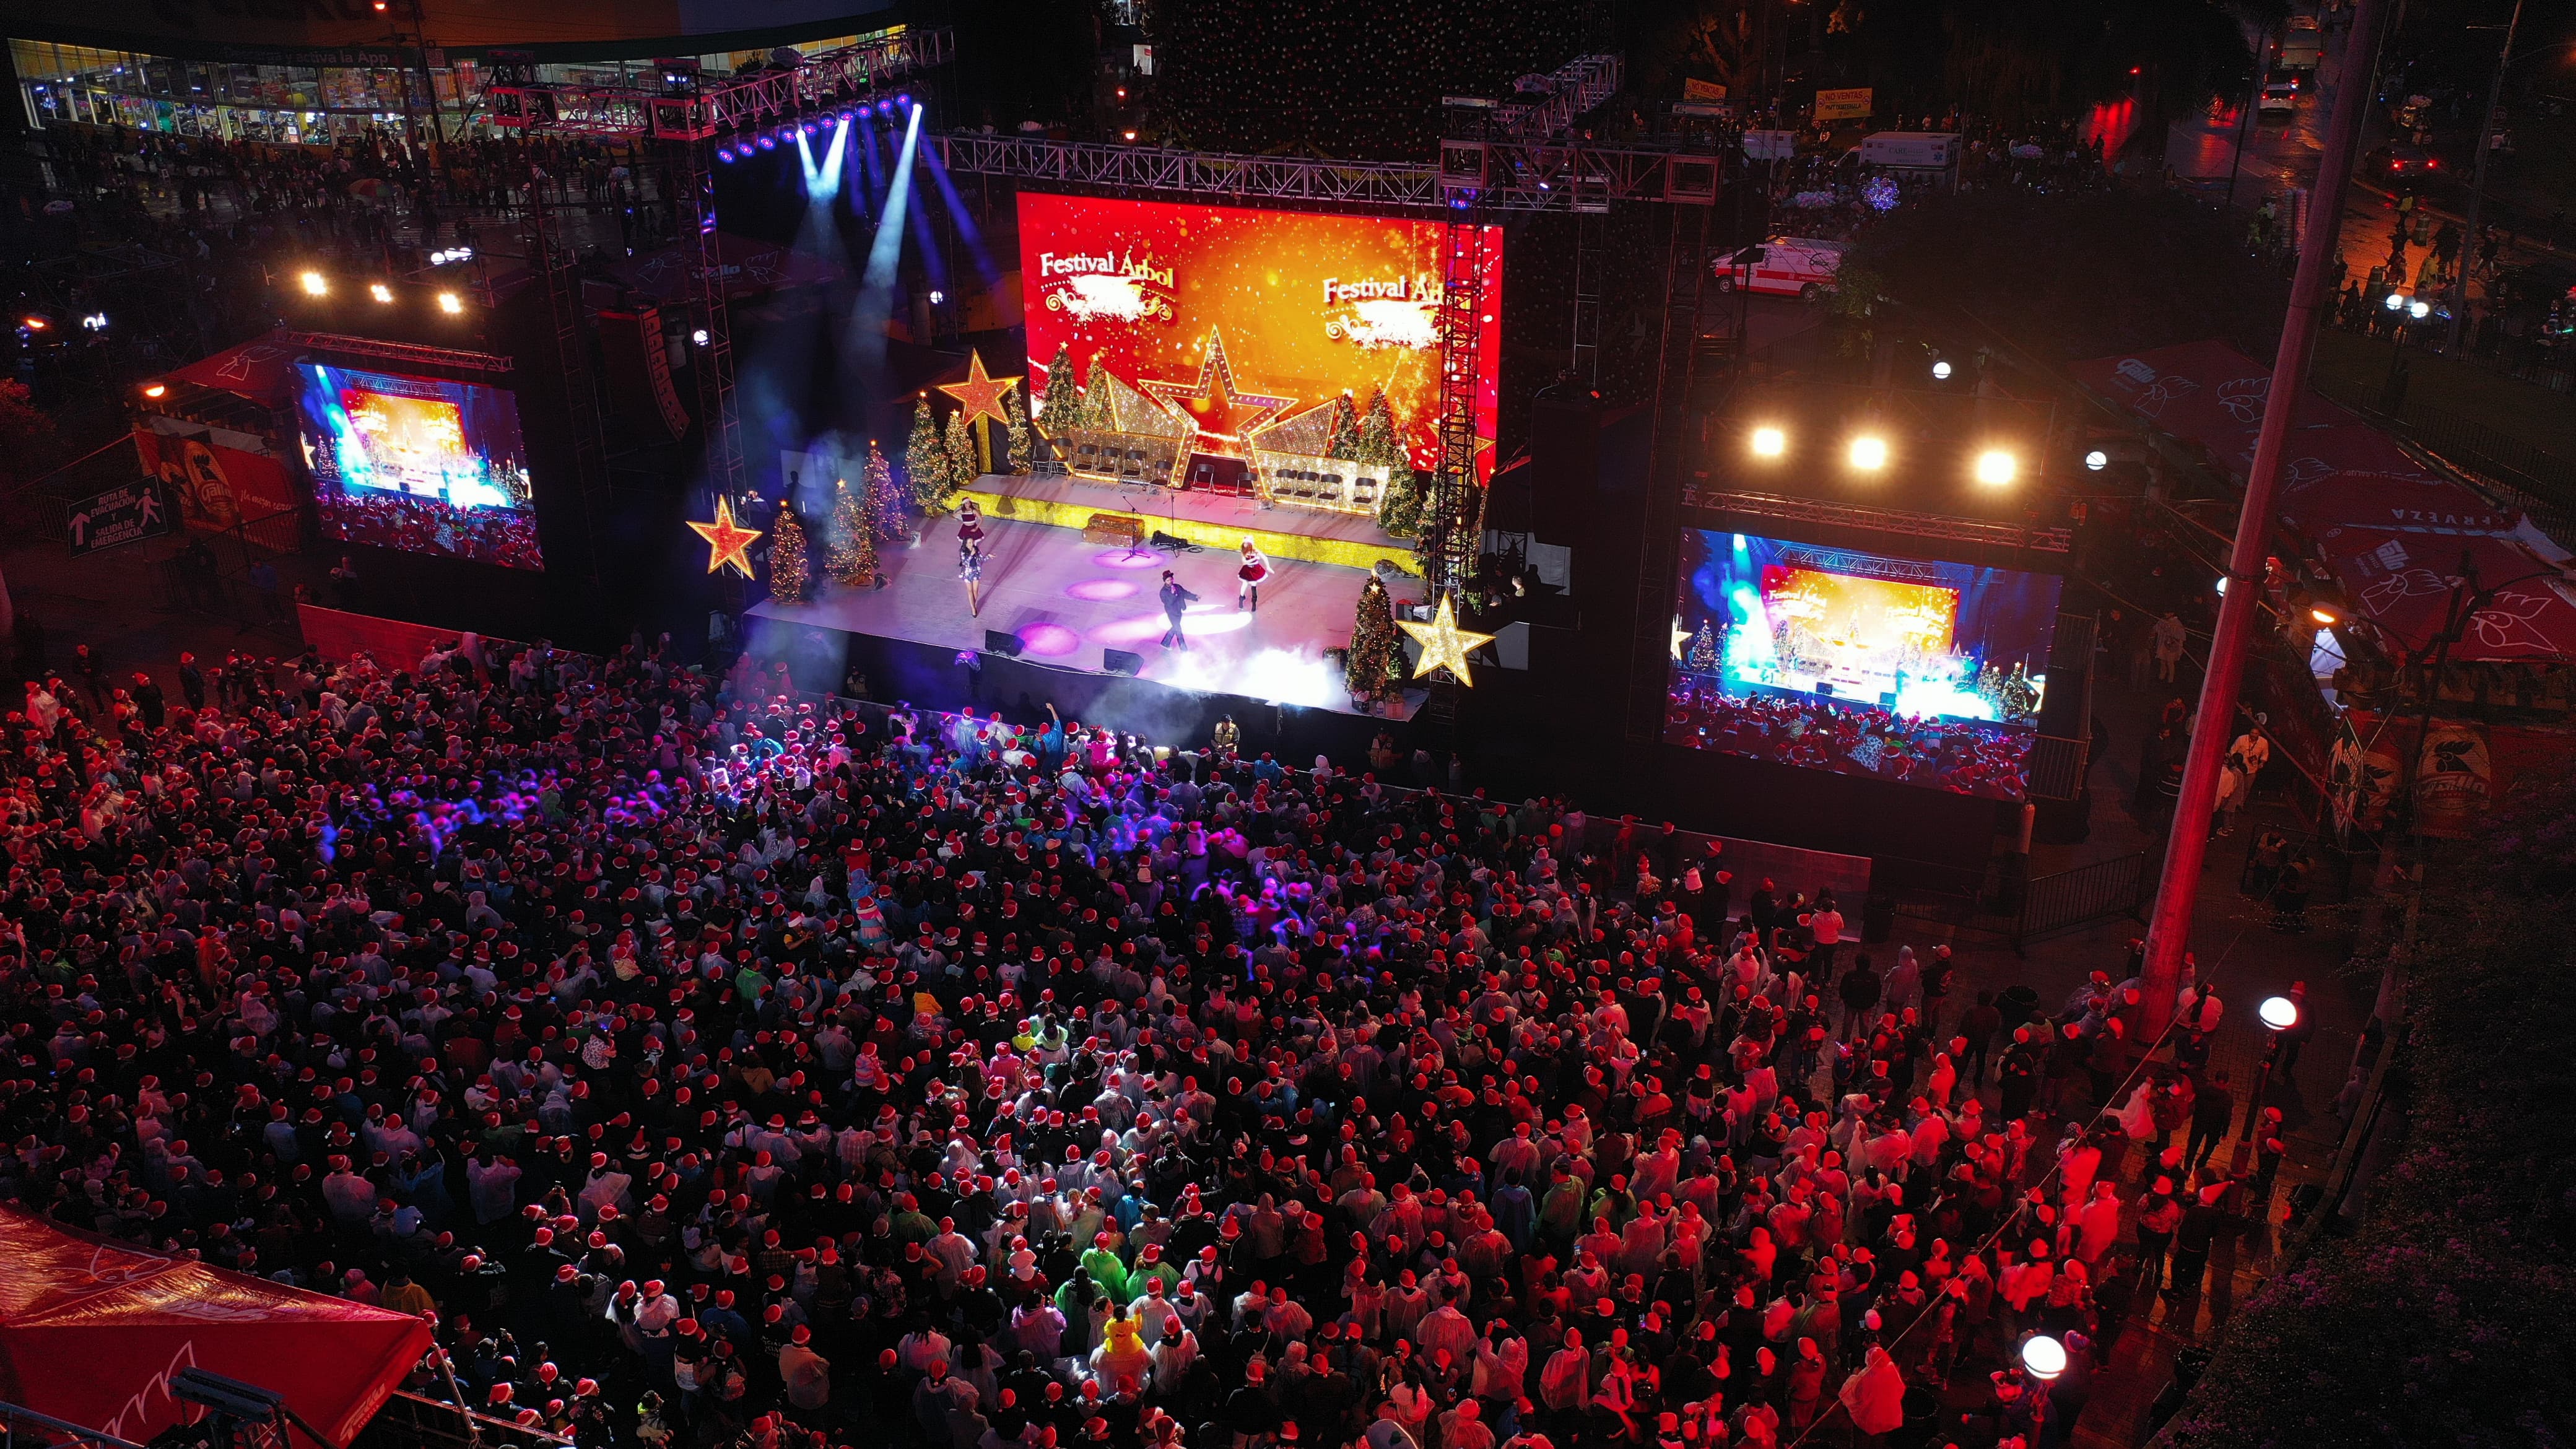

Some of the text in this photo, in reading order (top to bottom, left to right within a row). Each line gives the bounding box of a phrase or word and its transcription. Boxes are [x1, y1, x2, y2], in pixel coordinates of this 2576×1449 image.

[339, 50, 354, 63] la
[358, 50, 388, 67] App
[1837, 91, 1863, 100] VENTAS
[1040, 249, 1174, 289] Festival Árbol
[1323, 275, 1406, 303] Festival
[98, 488, 129, 505] RUTA DE
[201, 483, 232, 503] Gallo
[111, 513, 116, 521] Y
[95, 518, 136, 537] SALIDA DE
[90, 527, 144, 549] EMERGENCIA
[358, 1404, 380, 1428] CERVEZA
